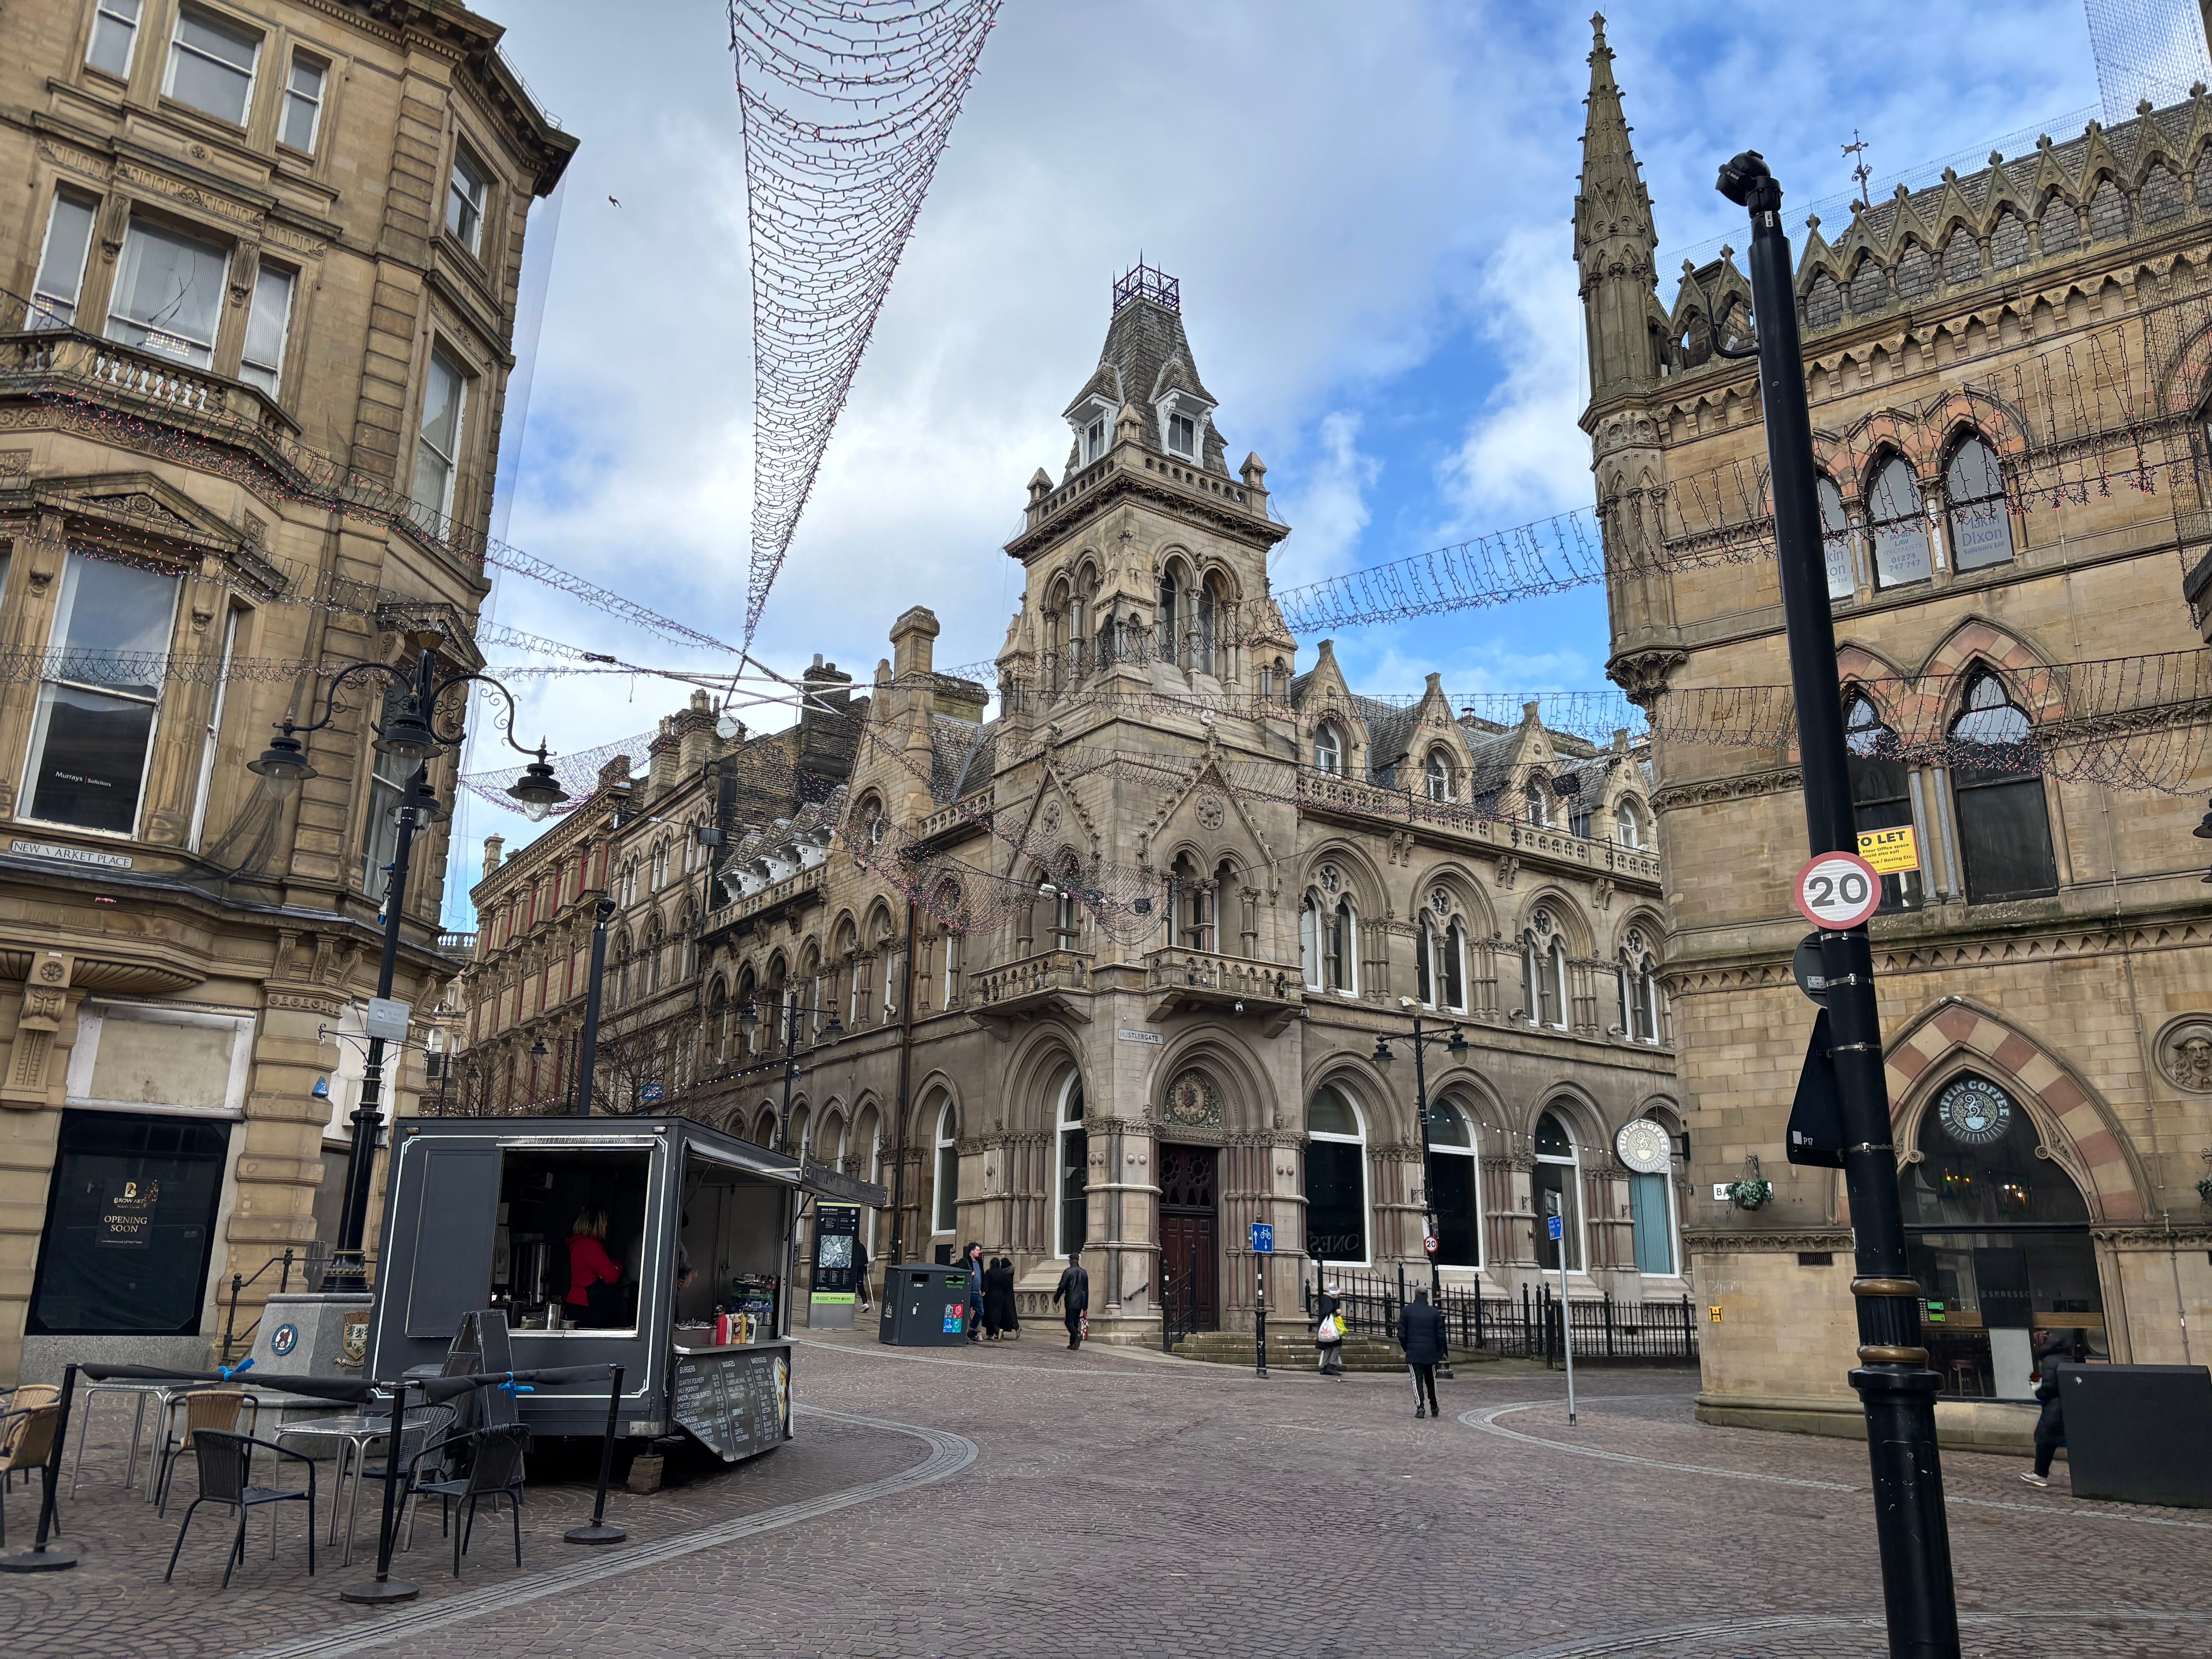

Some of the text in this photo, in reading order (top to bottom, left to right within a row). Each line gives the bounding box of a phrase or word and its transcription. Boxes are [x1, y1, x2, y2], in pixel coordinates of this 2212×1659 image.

[1890, 531, 1911, 541] FAMILY
[1962, 529, 2002, 546] Dixon
[1883, 543, 1922, 555] SPECIALISTS
[1964, 545, 1992, 555] Solicitors
[1826, 551, 1843, 563] kin
[1891, 553, 1915, 563] 01274
[1889, 560, 1920, 572] 747 747
[55, 771, 112, 787] Murrays Solicitors
[1857, 831, 1905, 847] O LET
[14, 842, 40, 853] NEW
[97, 855, 129, 867] PLACE
[1808, 873, 1868, 907] 20
[1120, 1031, 1158, 1042] HUSTLERGATE
[1940, 1080, 2009, 1120] TIFFIN COFFEE
[1620, 1121, 1668, 1151] TIFFIN COFFEE
[104, 1216, 148, 1224] OPENING
[1709, 1308, 1722, 1321] H
[680, 1365, 696, 1374] BURGERS
[732, 1407, 743, 1416] DRINKS
